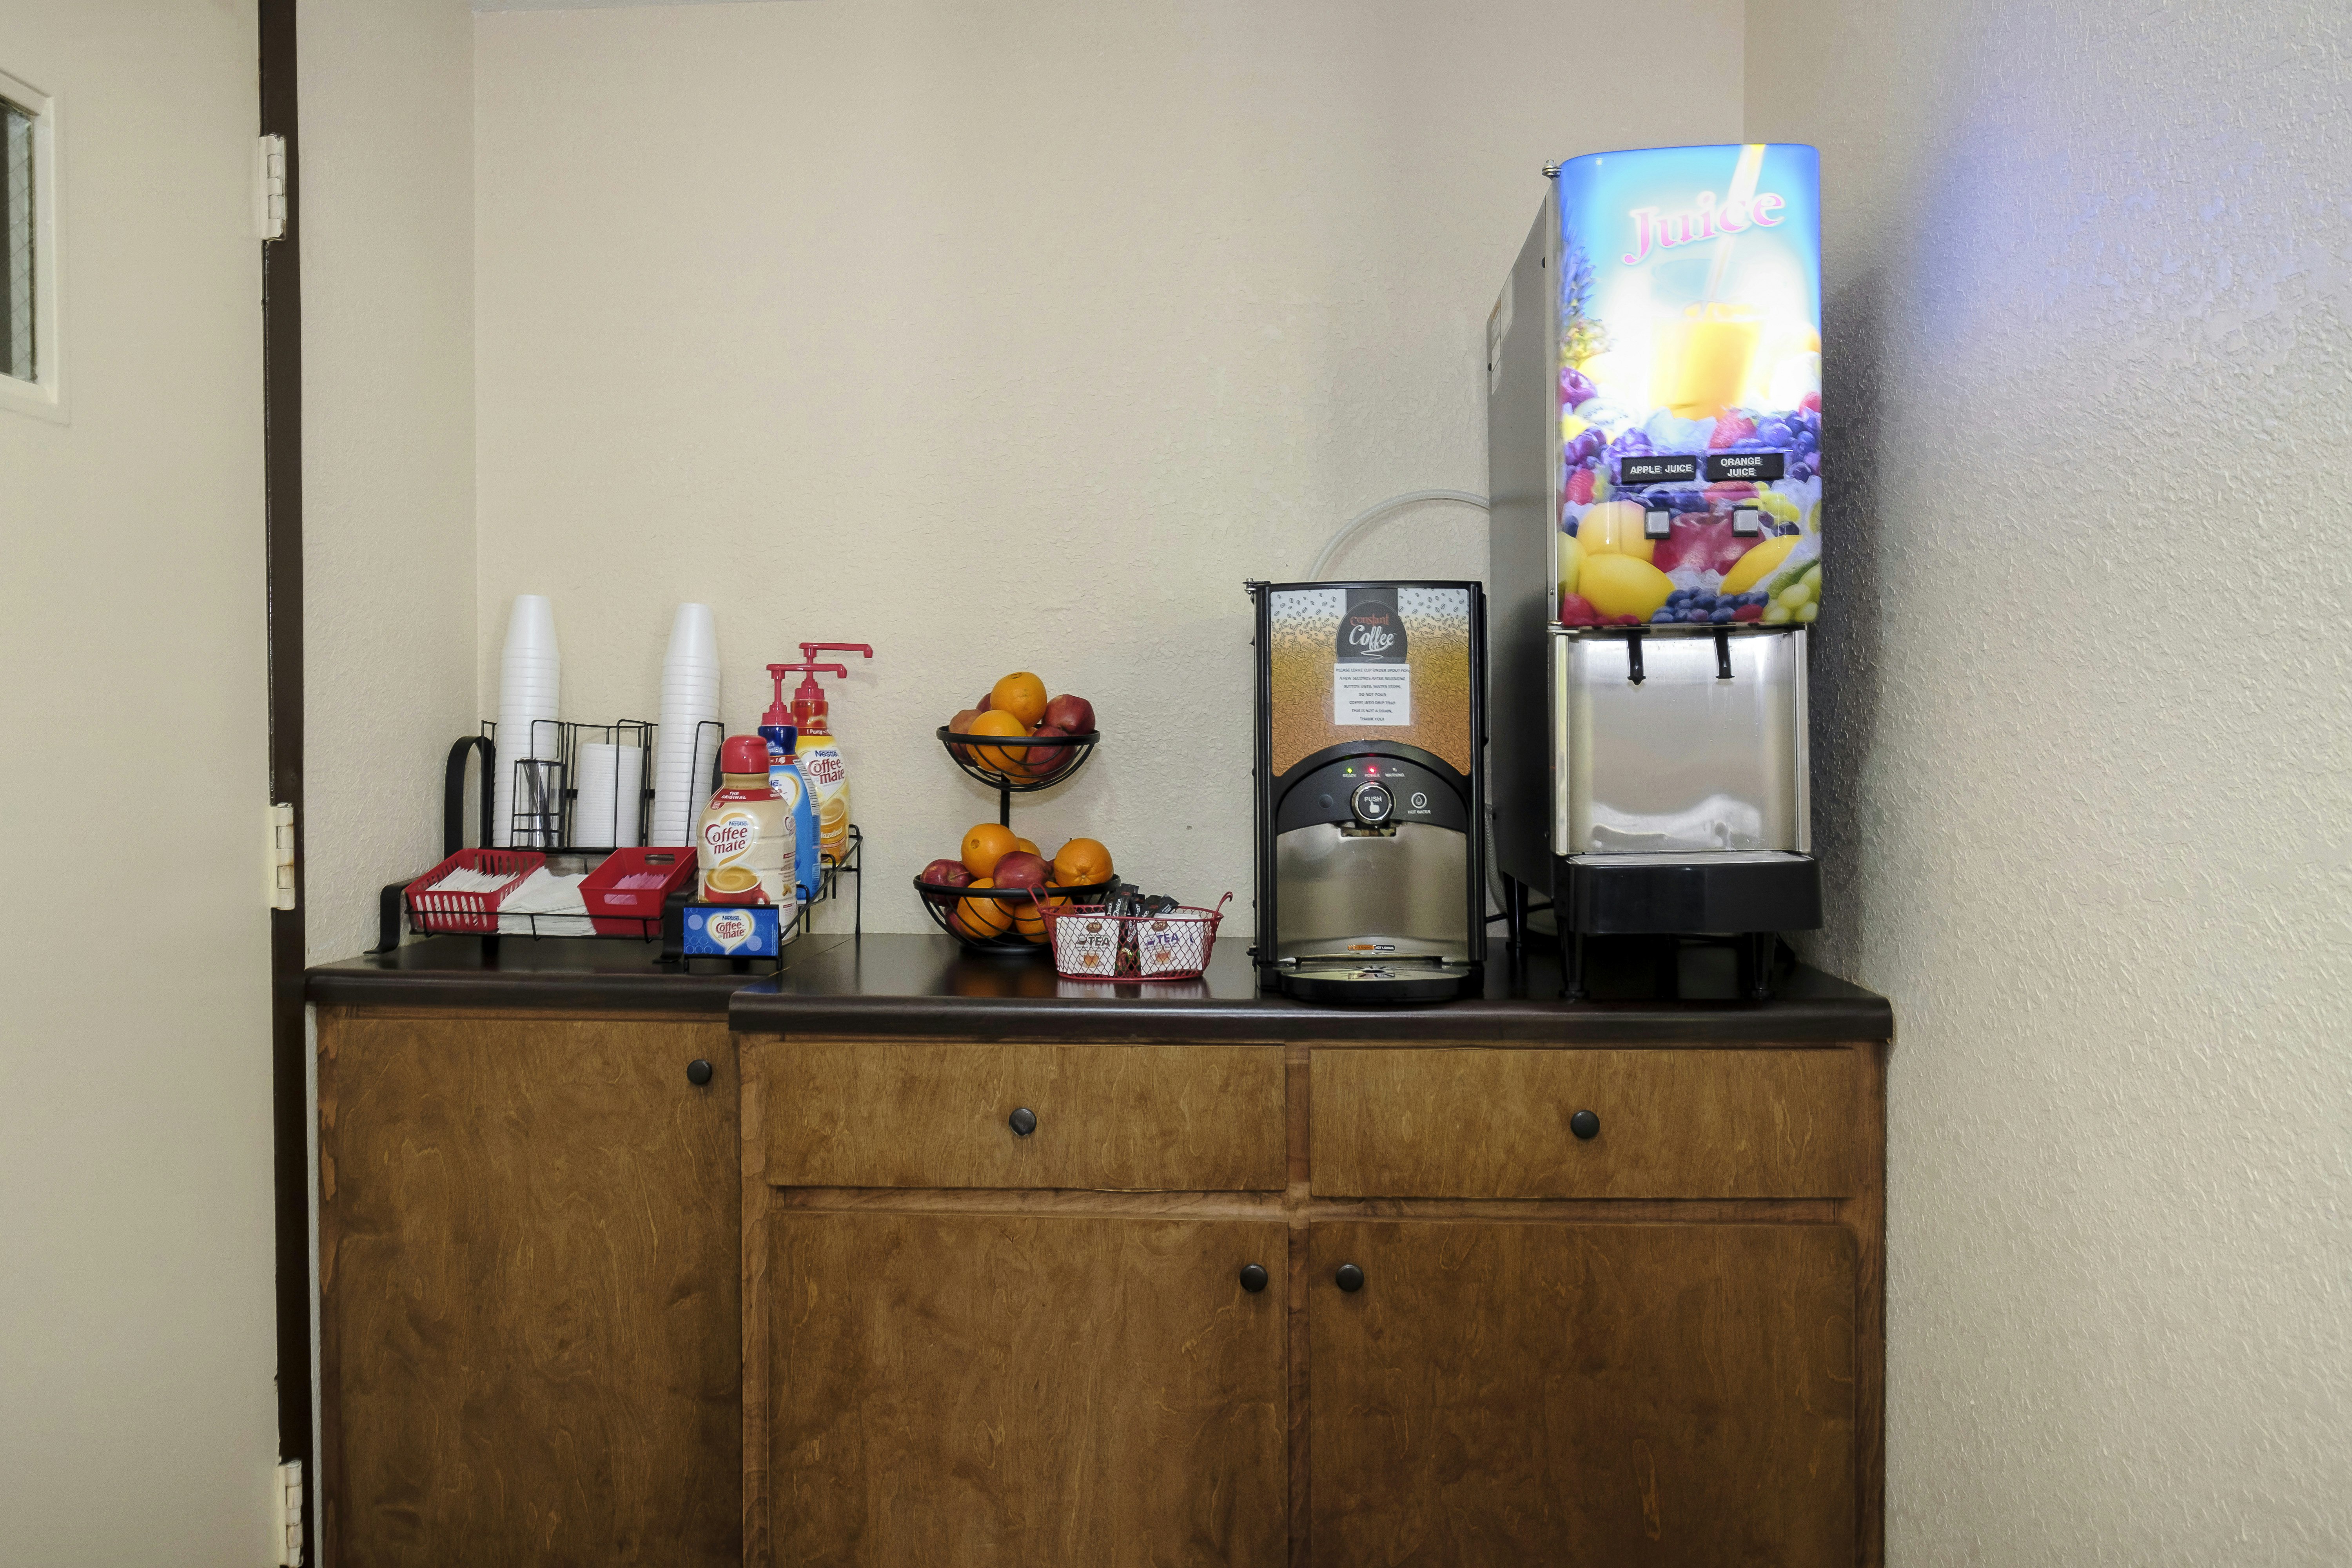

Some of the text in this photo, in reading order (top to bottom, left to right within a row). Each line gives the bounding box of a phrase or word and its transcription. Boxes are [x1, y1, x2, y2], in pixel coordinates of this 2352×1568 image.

[1621, 191, 1785, 265] Juice
[1720, 457, 1762, 466] ORANGE
[1630, 464, 1692, 474] APPLE JUICE
[1727, 468, 1755, 477] JUICE
[1349, 625, 1395, 651] Coffee
[820, 768, 844, 784] mate
[705, 824, 748, 845] Coffee
[713, 840, 746, 855] mate
[1113, 898, 1122, 917] Choice
[723, 929, 744, 939] mate
[1156, 933, 1180, 943] TEA
[1089, 936, 1110, 947] TEA
